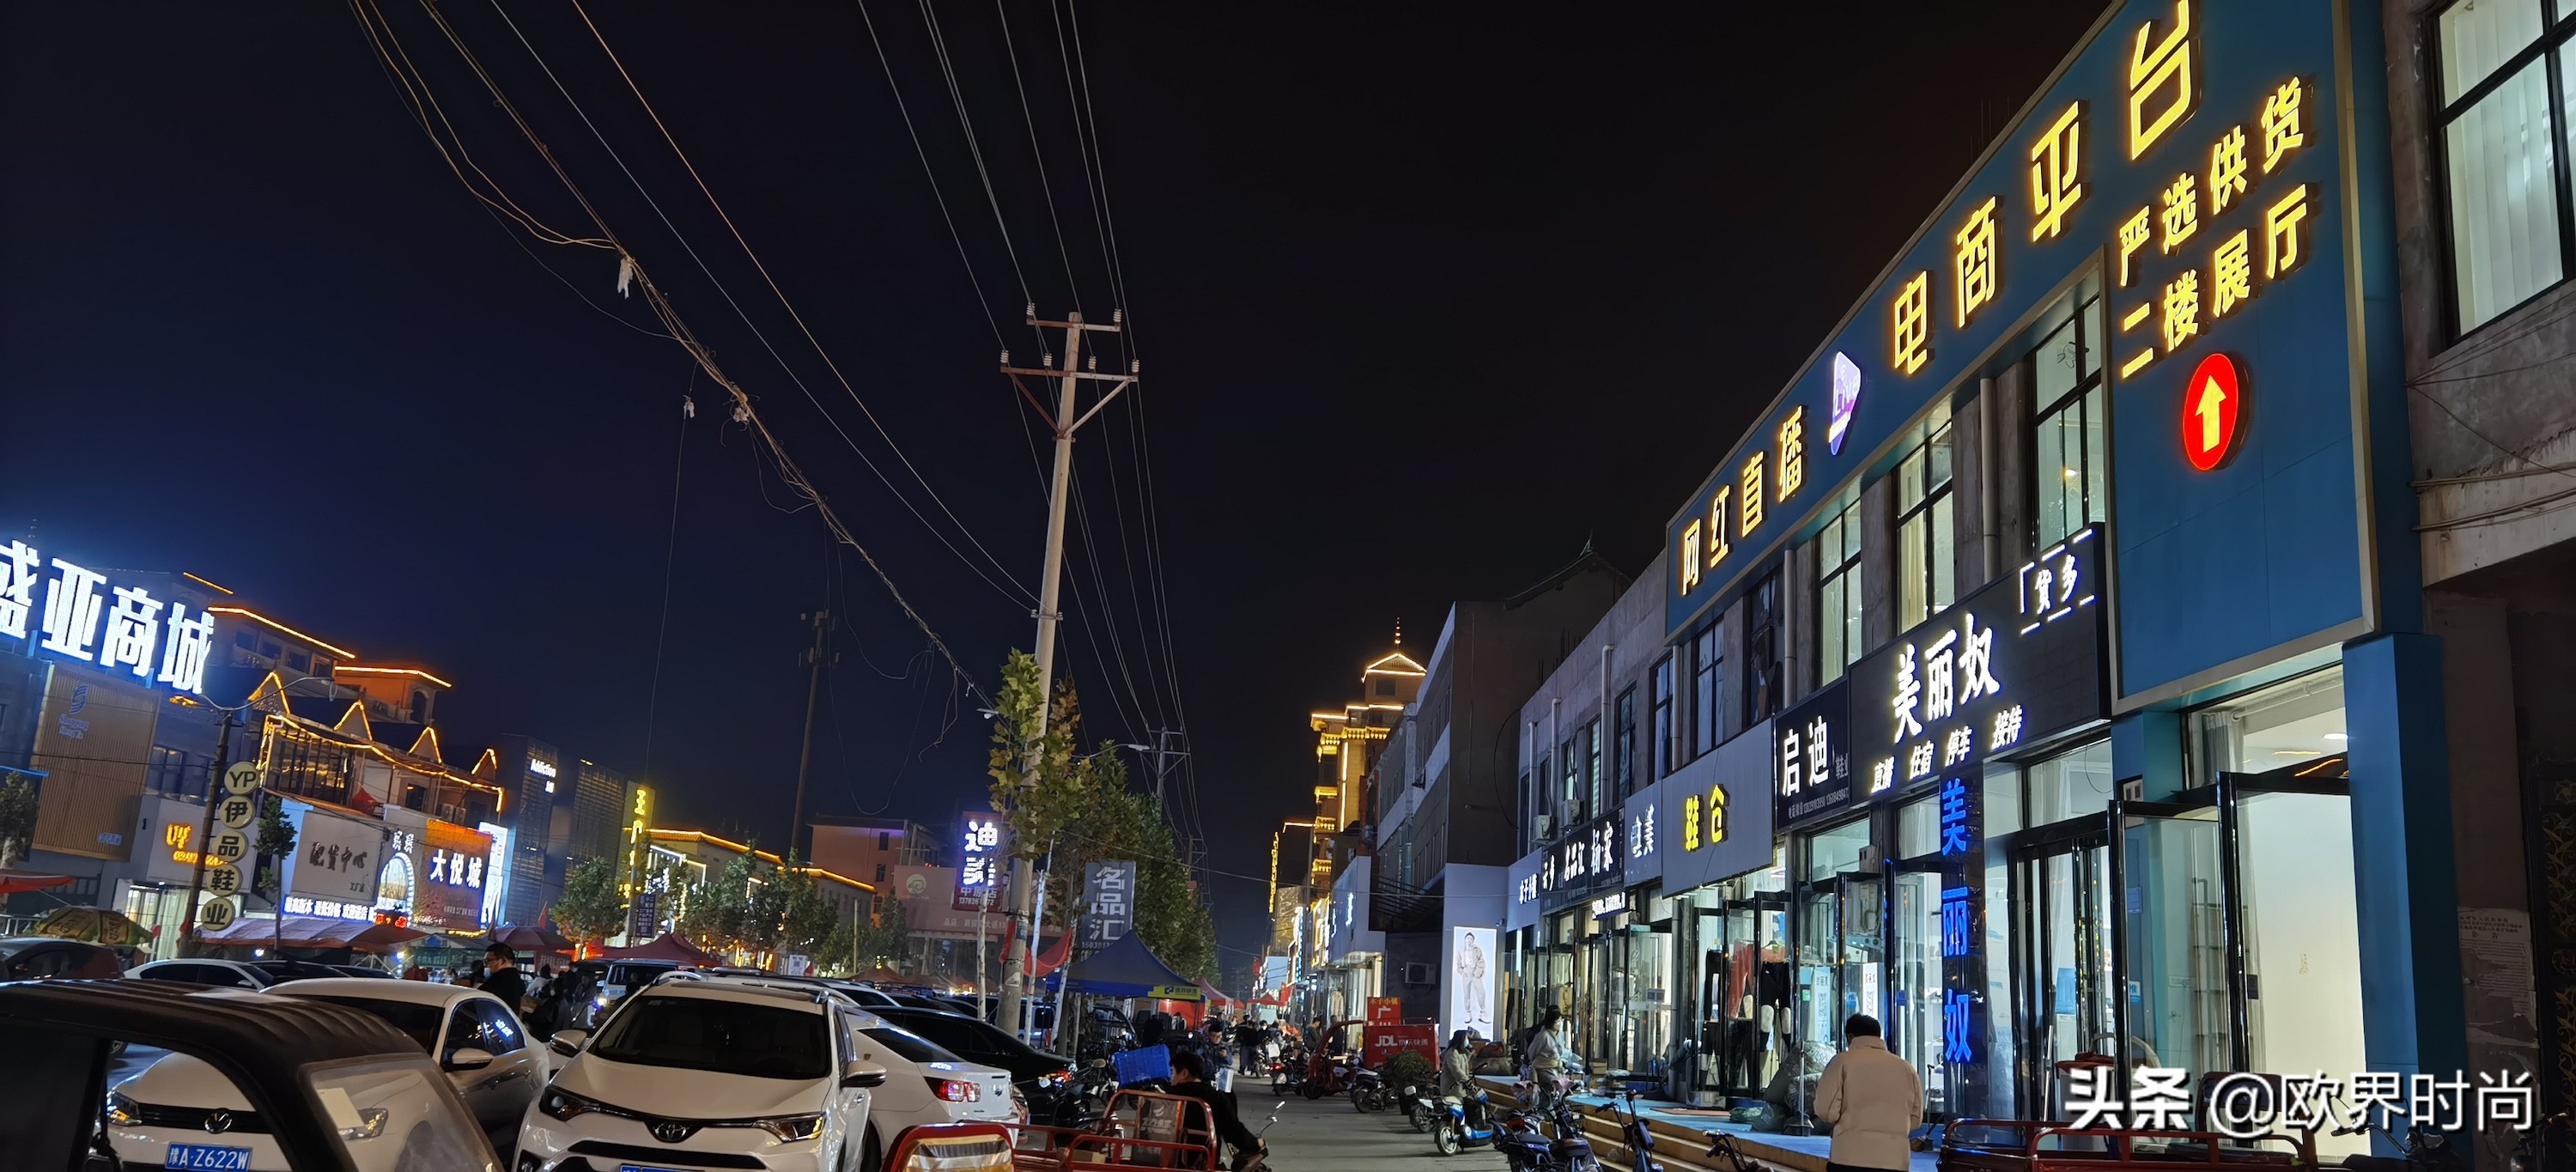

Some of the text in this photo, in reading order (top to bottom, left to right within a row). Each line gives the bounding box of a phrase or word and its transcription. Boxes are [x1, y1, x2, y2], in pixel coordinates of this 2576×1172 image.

[1892, 0, 2195, 376] 电商平台
[2118, 76, 2305, 287] 严选供货
[2121, 184, 2307, 380] 二楼展厅
[1681, 405, 1806, 596] 网红直播
[1892, 613, 2001, 744] 美丽奴
[229, 771, 257, 787] YP
[1686, 784, 1725, 852] 鞋仓
[1783, 715, 1829, 797] 启迪
[204, 801, 248, 925] 伊品鞋业
[430, 849, 483, 888] 大悦城
[1091, 866, 1126, 940] 名品汇
[1941, 777, 1972, 1063] 美丽奴
[1375, 1035, 1398, 1048] JDL
